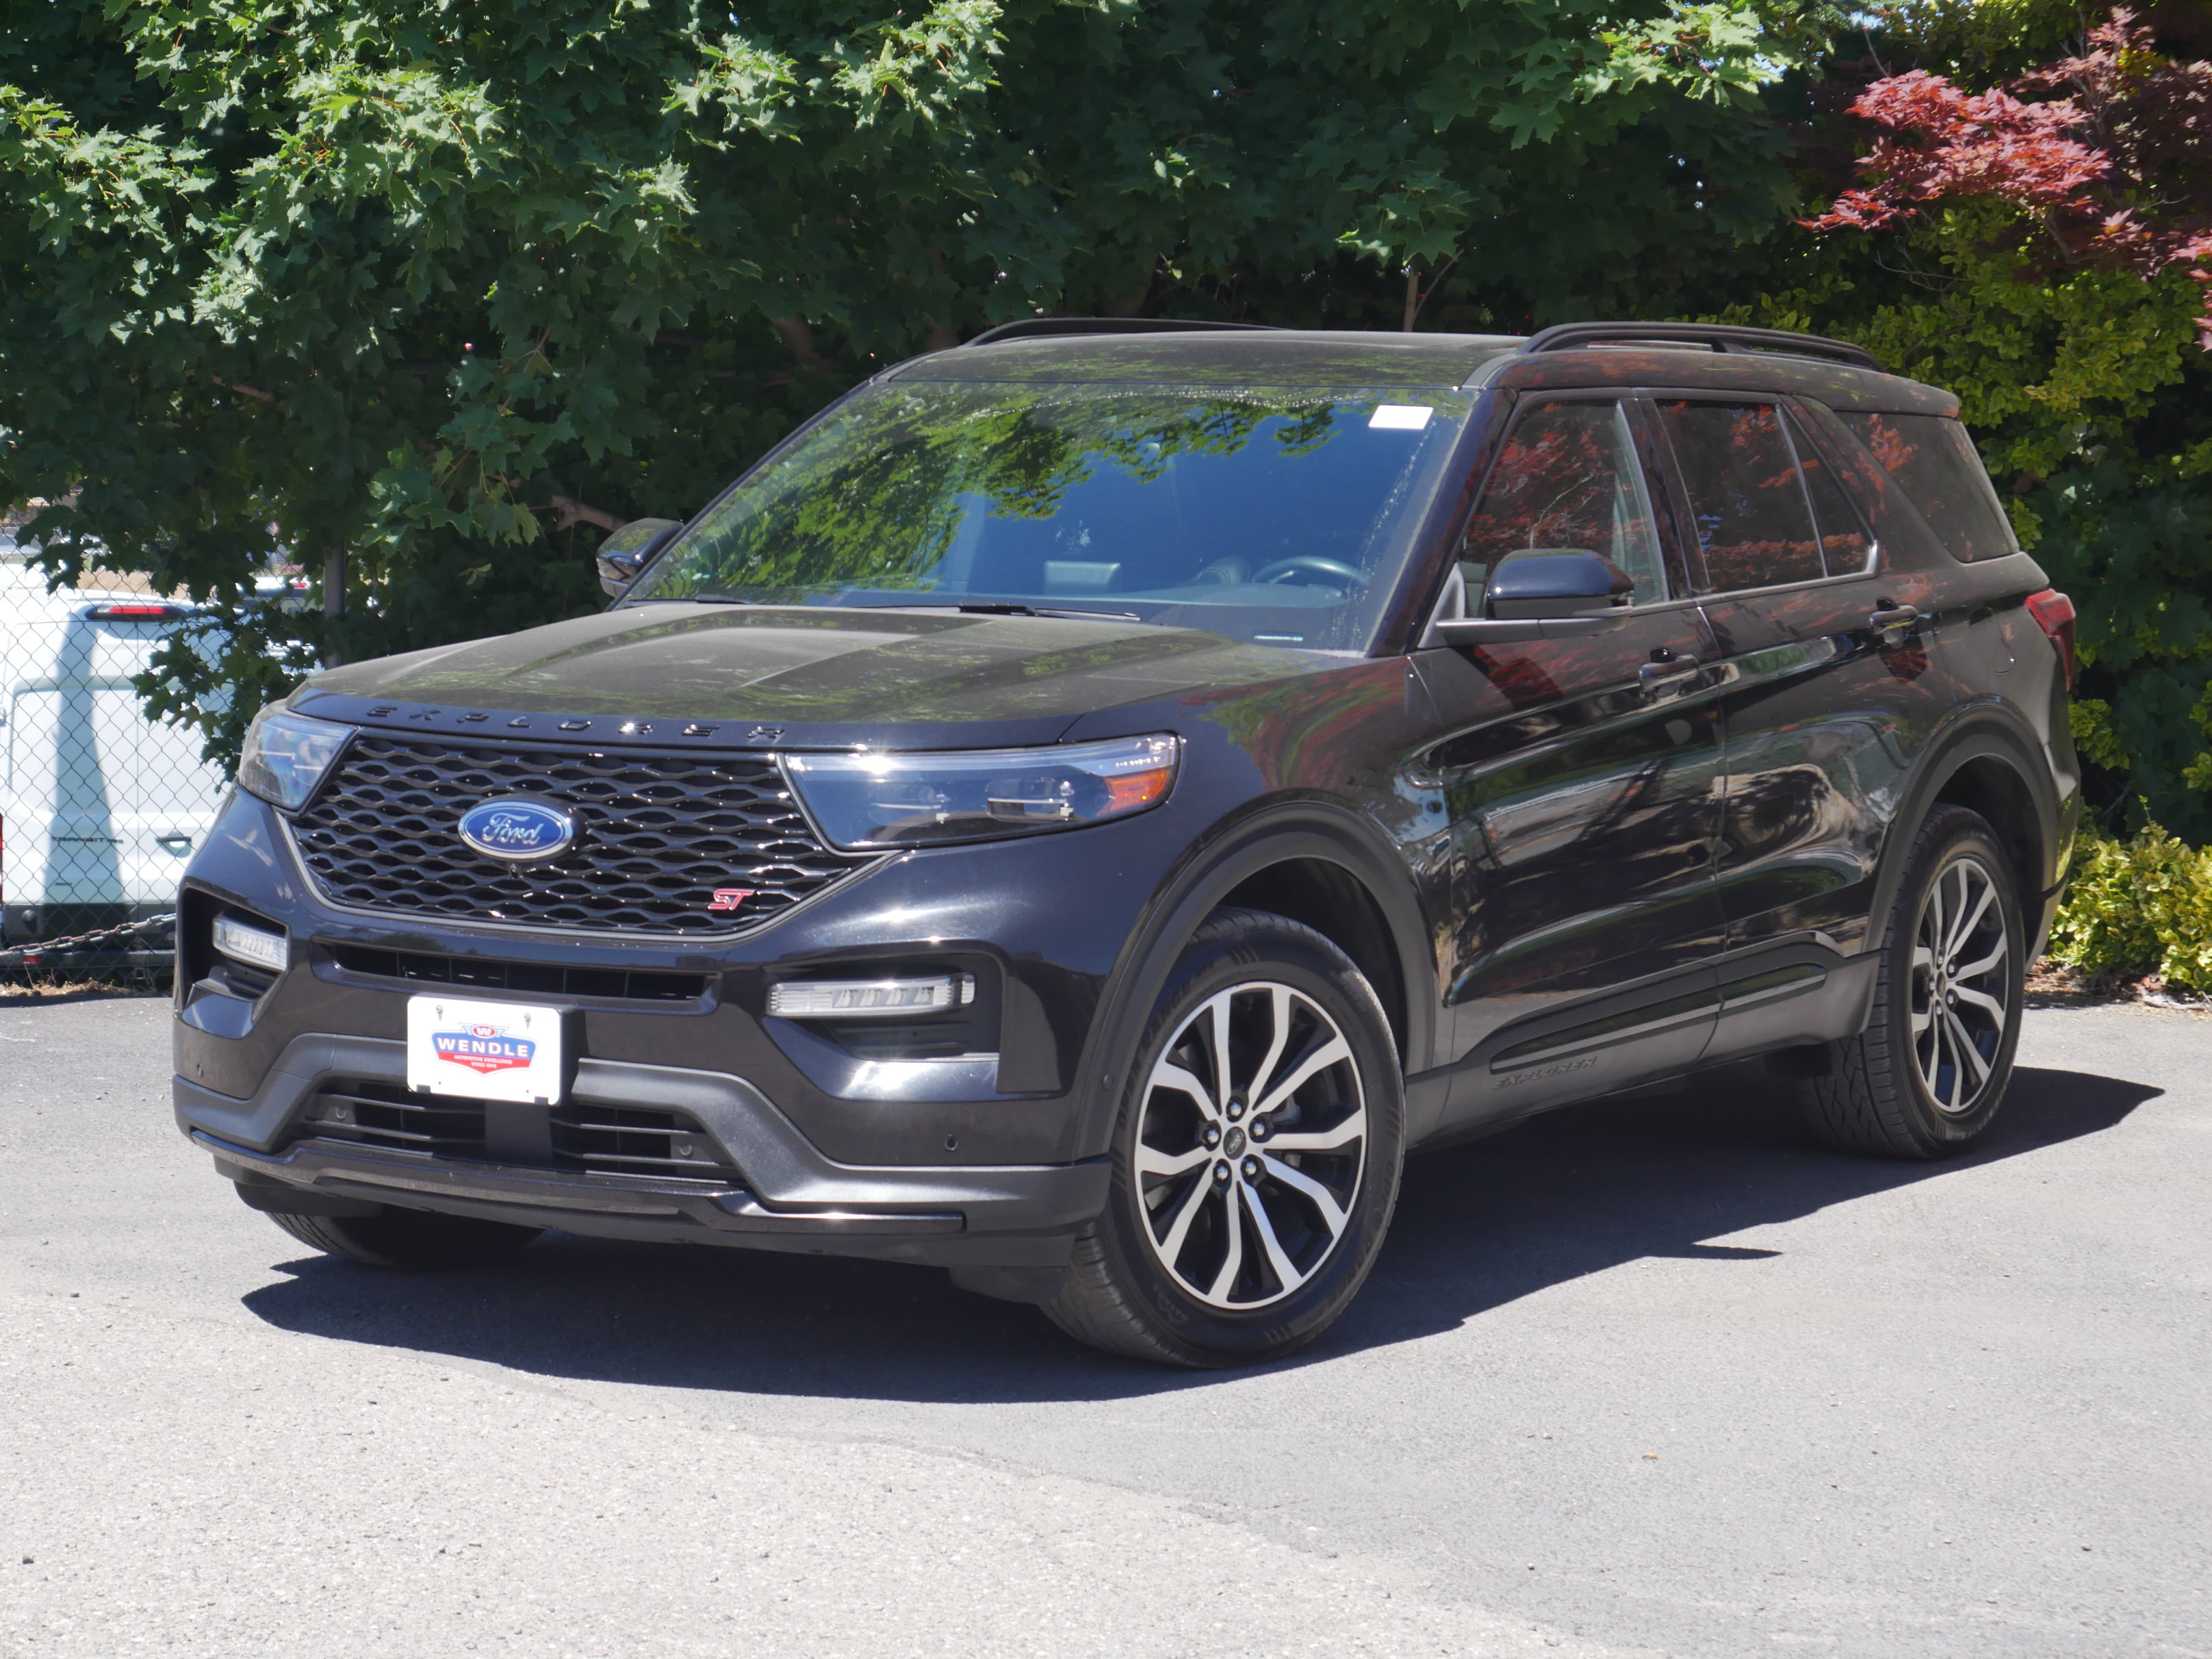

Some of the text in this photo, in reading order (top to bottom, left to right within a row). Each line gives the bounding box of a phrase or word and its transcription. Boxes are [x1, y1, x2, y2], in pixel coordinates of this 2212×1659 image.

[367, 706, 785, 738] EXPLORER
[482, 812, 544, 845] Ford
[708, 889, 754, 910] ST
[476, 1027, 492, 1036] W
[437, 1038, 528, 1057] WENDLE
[1492, 1056, 1597, 1090] EXPLORER
